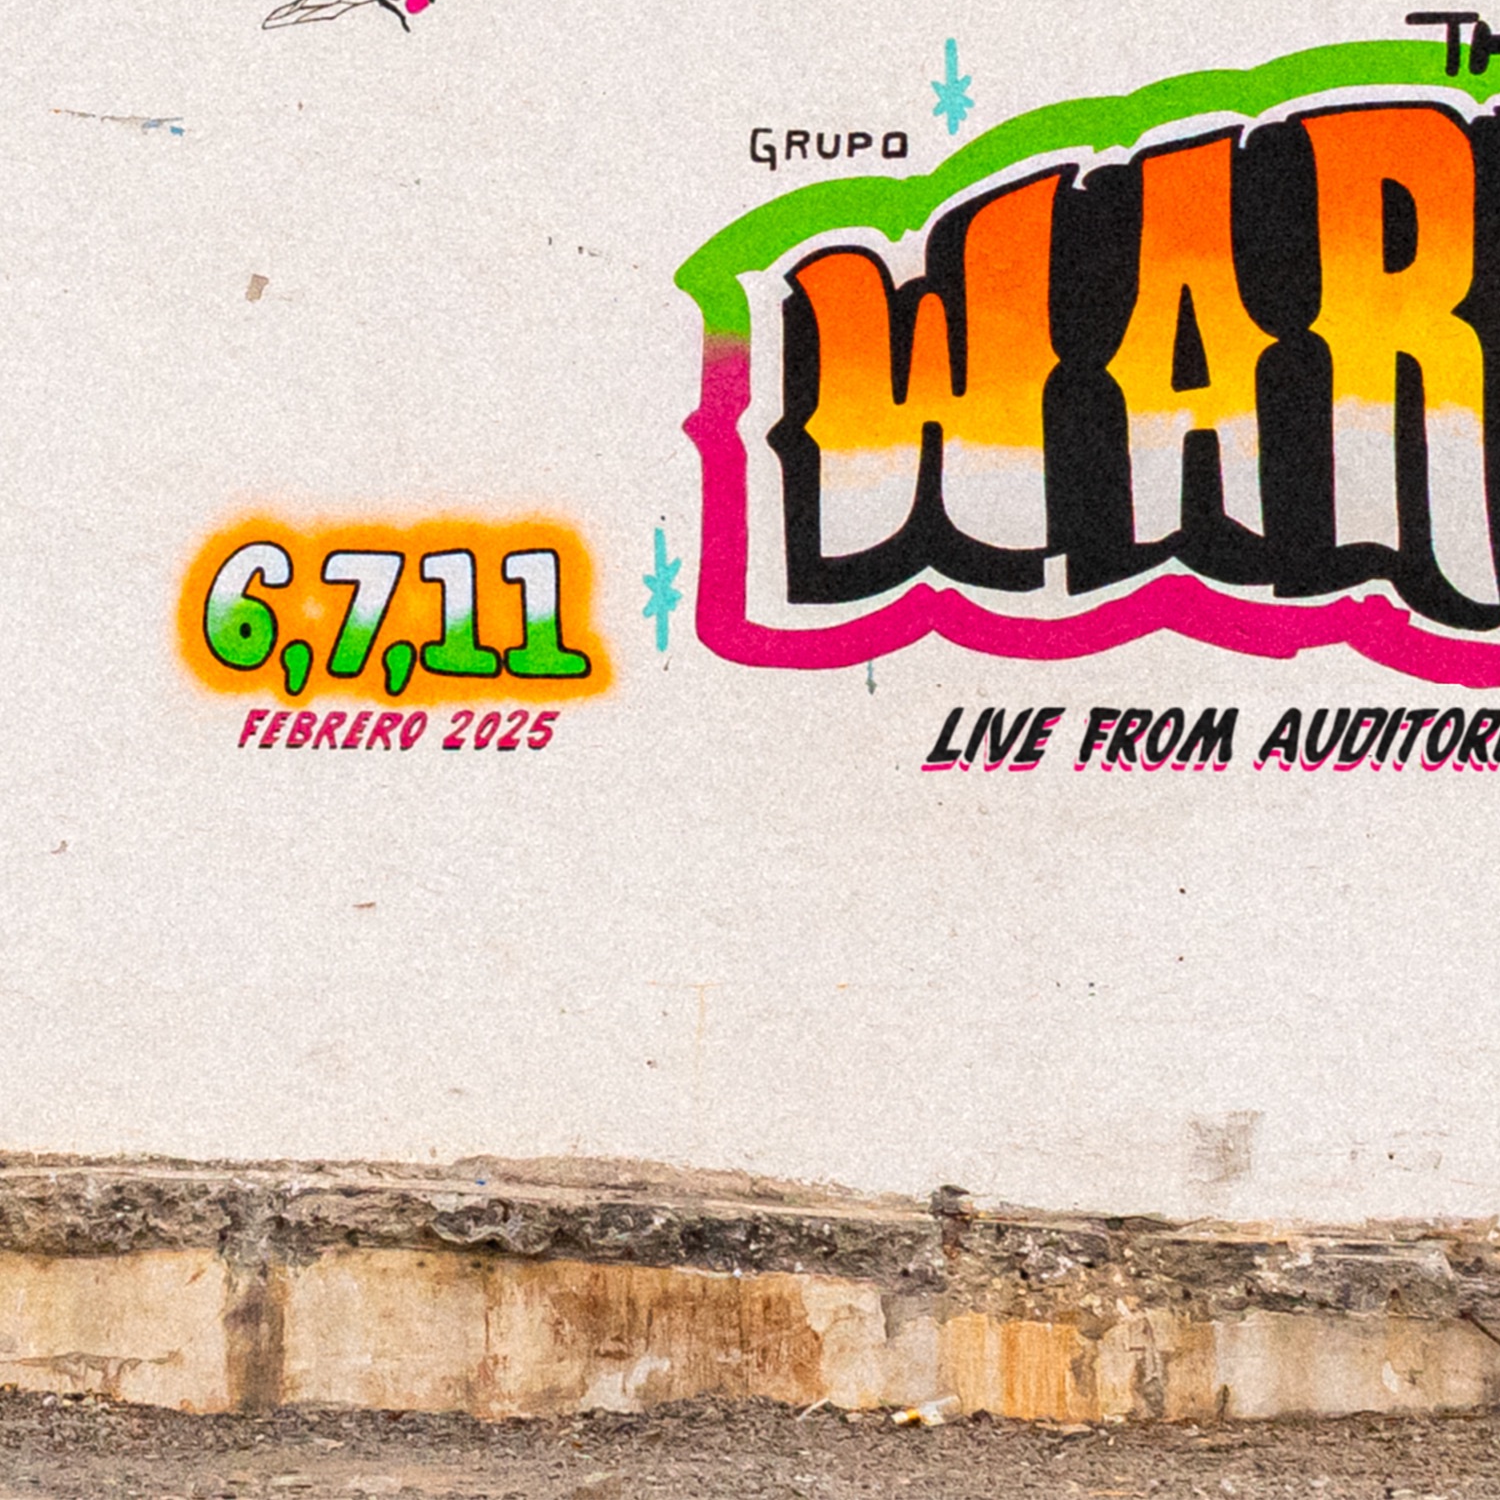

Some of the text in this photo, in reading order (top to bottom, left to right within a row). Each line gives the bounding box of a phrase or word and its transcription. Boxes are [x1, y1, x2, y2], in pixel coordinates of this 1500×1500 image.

[750, 128, 908, 171] GRUPO
[203, 541, 592, 696] 6,7,11
[237, 709, 560, 751] FEBRERO 2025
[920, 707, 1065, 772] LIVE
[1073, 707, 1239, 772] FROM
